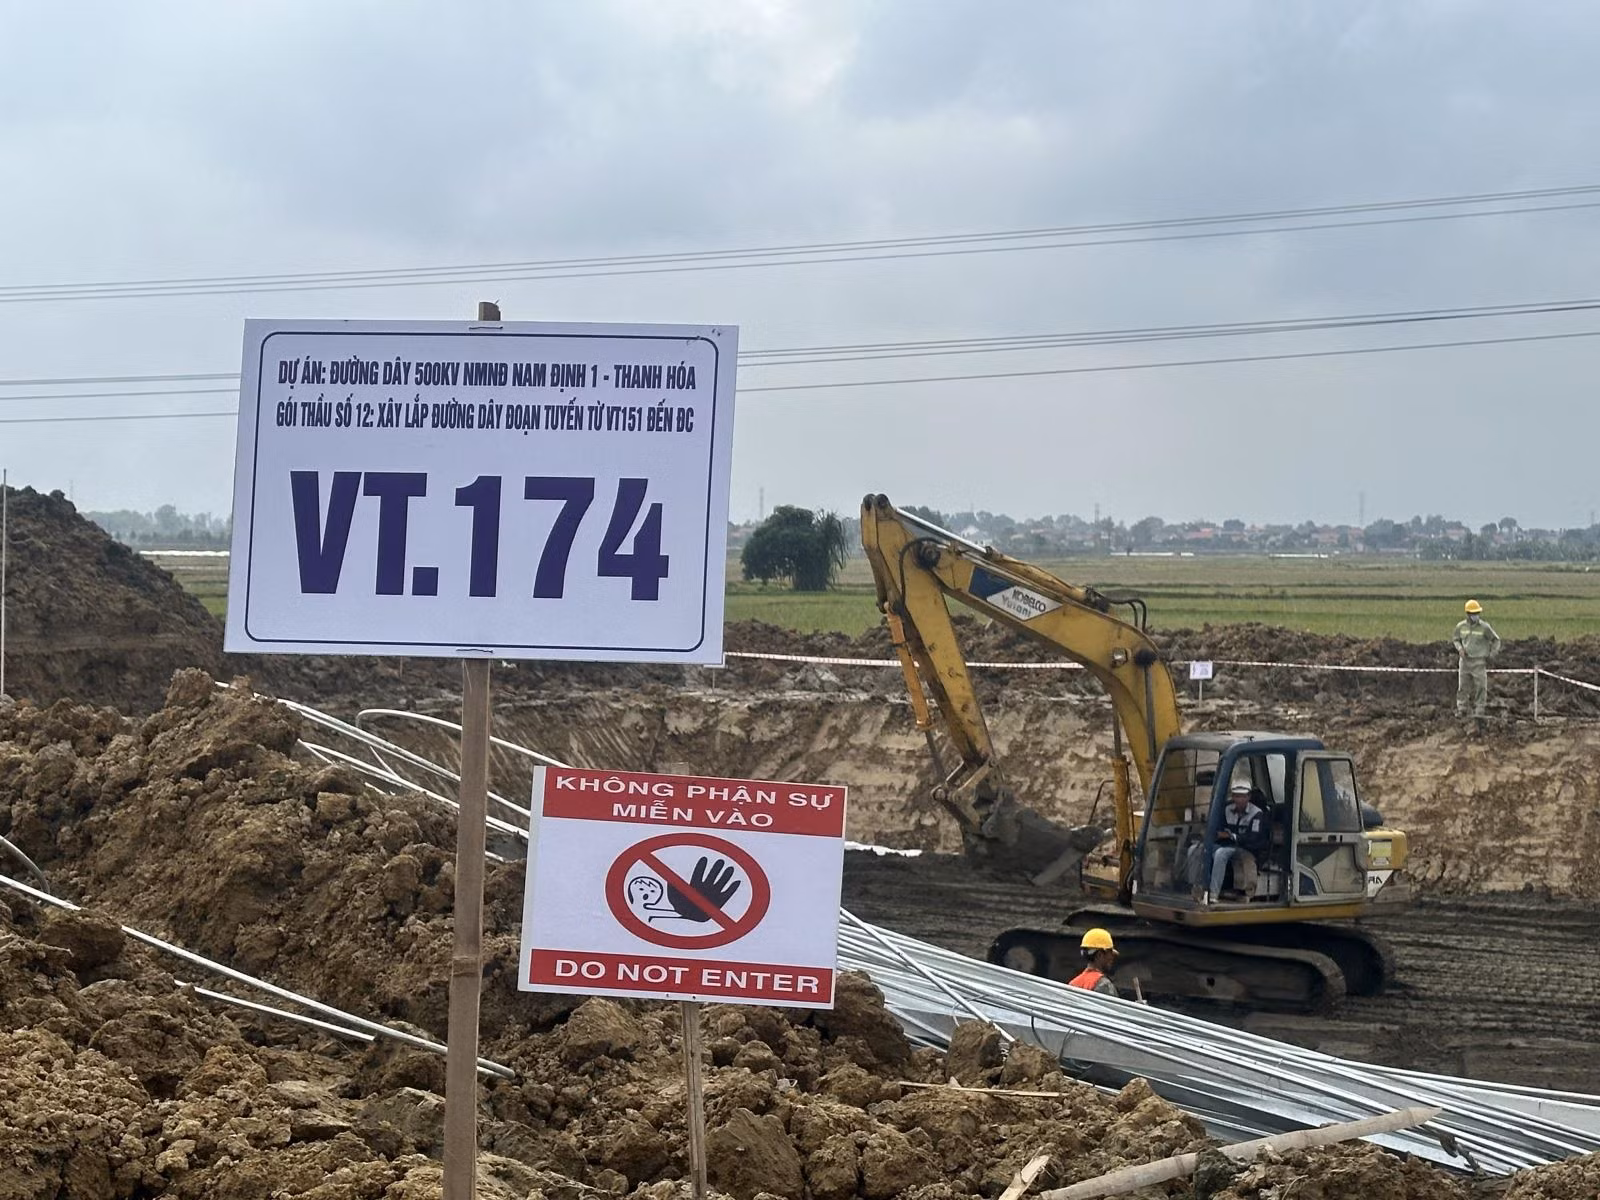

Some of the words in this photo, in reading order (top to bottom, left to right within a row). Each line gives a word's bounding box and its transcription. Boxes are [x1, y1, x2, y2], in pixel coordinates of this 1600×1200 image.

[278, 358, 299, 389] DỰ
[301, 355, 326, 384] ÁN:
[330, 355, 379, 385] ĐƯỜNG
[382, 356, 412, 385] DÂY
[414, 362, 460, 386] 500KV
[463, 362, 508, 387] NMNĐ
[512, 363, 547, 387] NAM
[550, 363, 586, 393] ĐỊNH
[590, 364, 598, 388] 1
[614, 364, 662, 389] THANH
[666, 360, 696, 390] HÓA
[276, 396, 297, 427] GÓI
[301, 393, 332, 427] THẦU
[335, 393, 353, 428] SỐ
[356, 402, 375, 428] 12:
[377, 397, 402, 428] XÂY
[404, 393, 429, 429] LẮP
[431, 397, 475, 429] ĐƯỜNG
[477, 399, 503, 430] DÂY
[505, 404, 541, 436] ĐOẠN
[544, 397, 584, 431] TUYẾN
[588, 400, 605, 431] TỪ
[606, 405, 643, 432] VT151
[646, 398, 674, 433] ĐẾN
[676, 407, 694, 433] ĐC
[290, 470, 670, 601] VT.174
[1012, 589, 1046, 612] KOBELCO
[555, 776, 674, 797] KHÔNG
[687, 785, 776, 806] PHẬN
[788, 793, 834, 811] SỰ
[612, 799, 693, 822] MIỄN
[705, 808, 773, 827] VÀO
[555, 959, 606, 979] DO
[617, 963, 689, 985] NOT
[701, 969, 820, 994] ENTER
